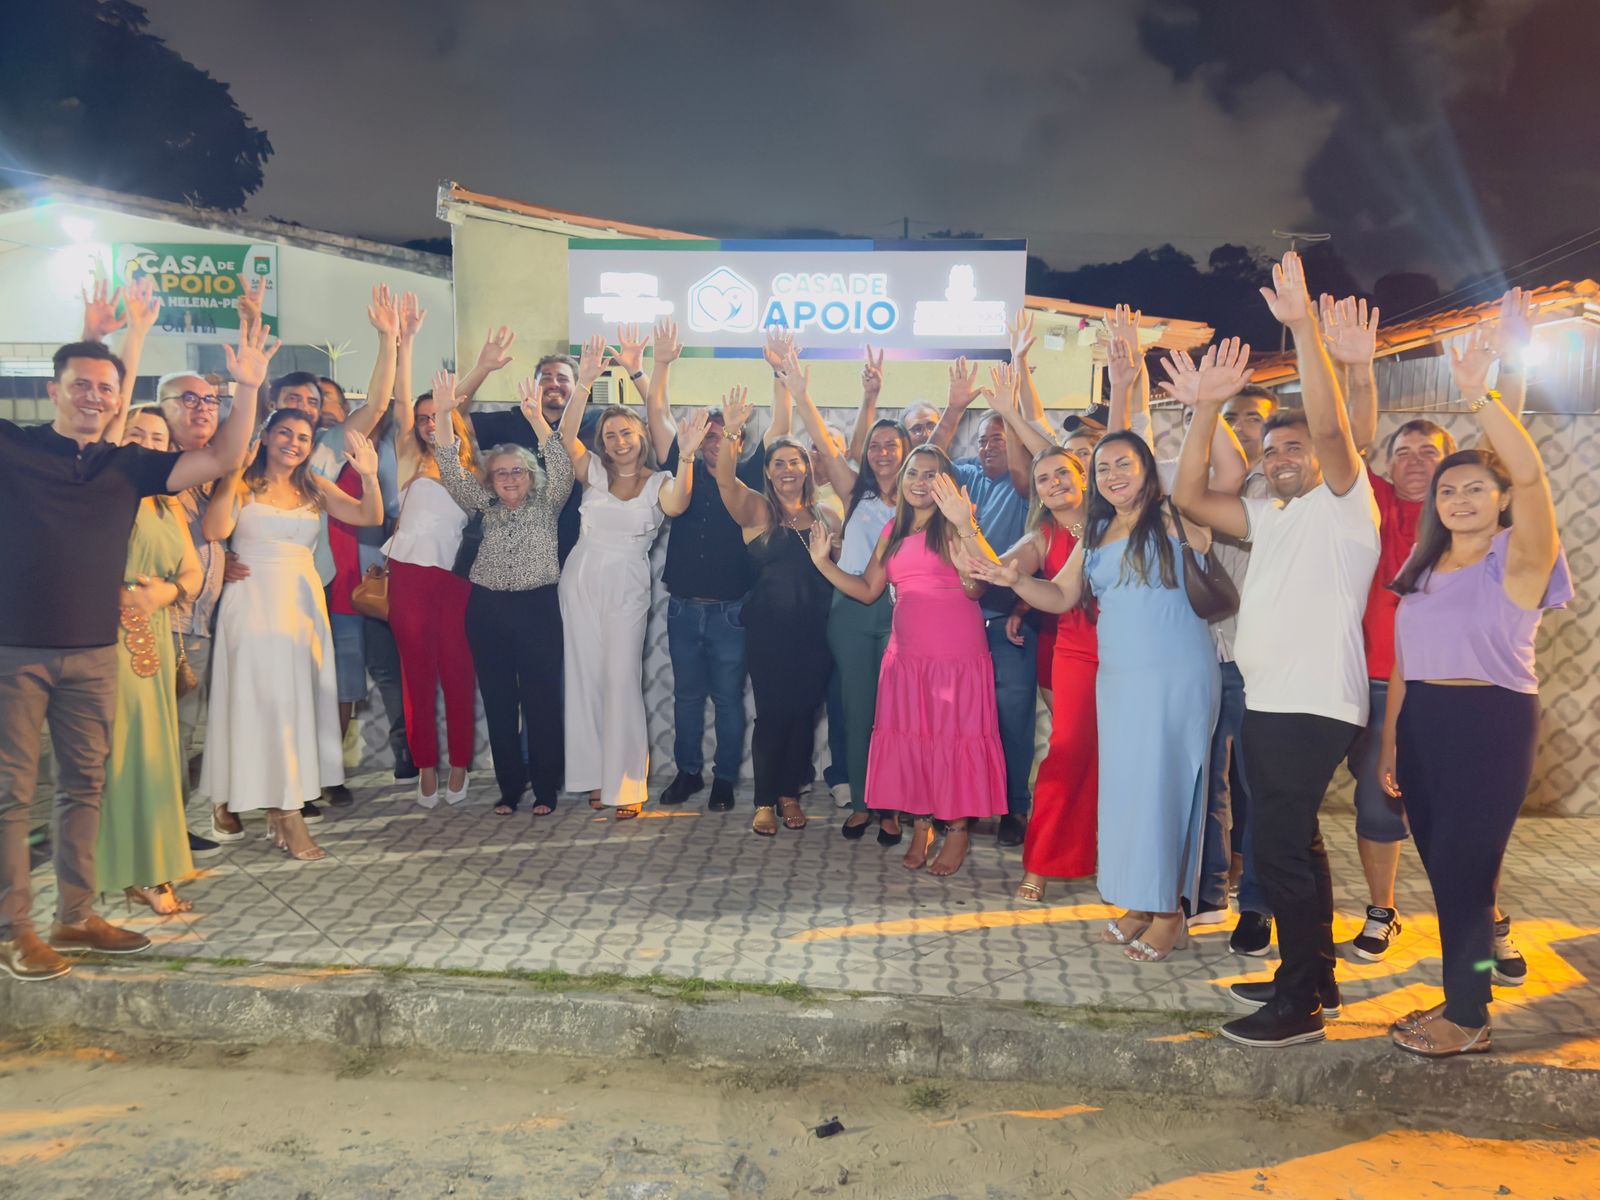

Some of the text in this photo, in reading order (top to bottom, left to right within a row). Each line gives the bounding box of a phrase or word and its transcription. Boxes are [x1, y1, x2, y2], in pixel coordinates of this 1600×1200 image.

[140, 254, 235, 275] CASA DE
[144, 273, 236, 294] APOIO
[774, 275, 885, 295] CASA DE
[763, 300, 896, 331] APOIO
